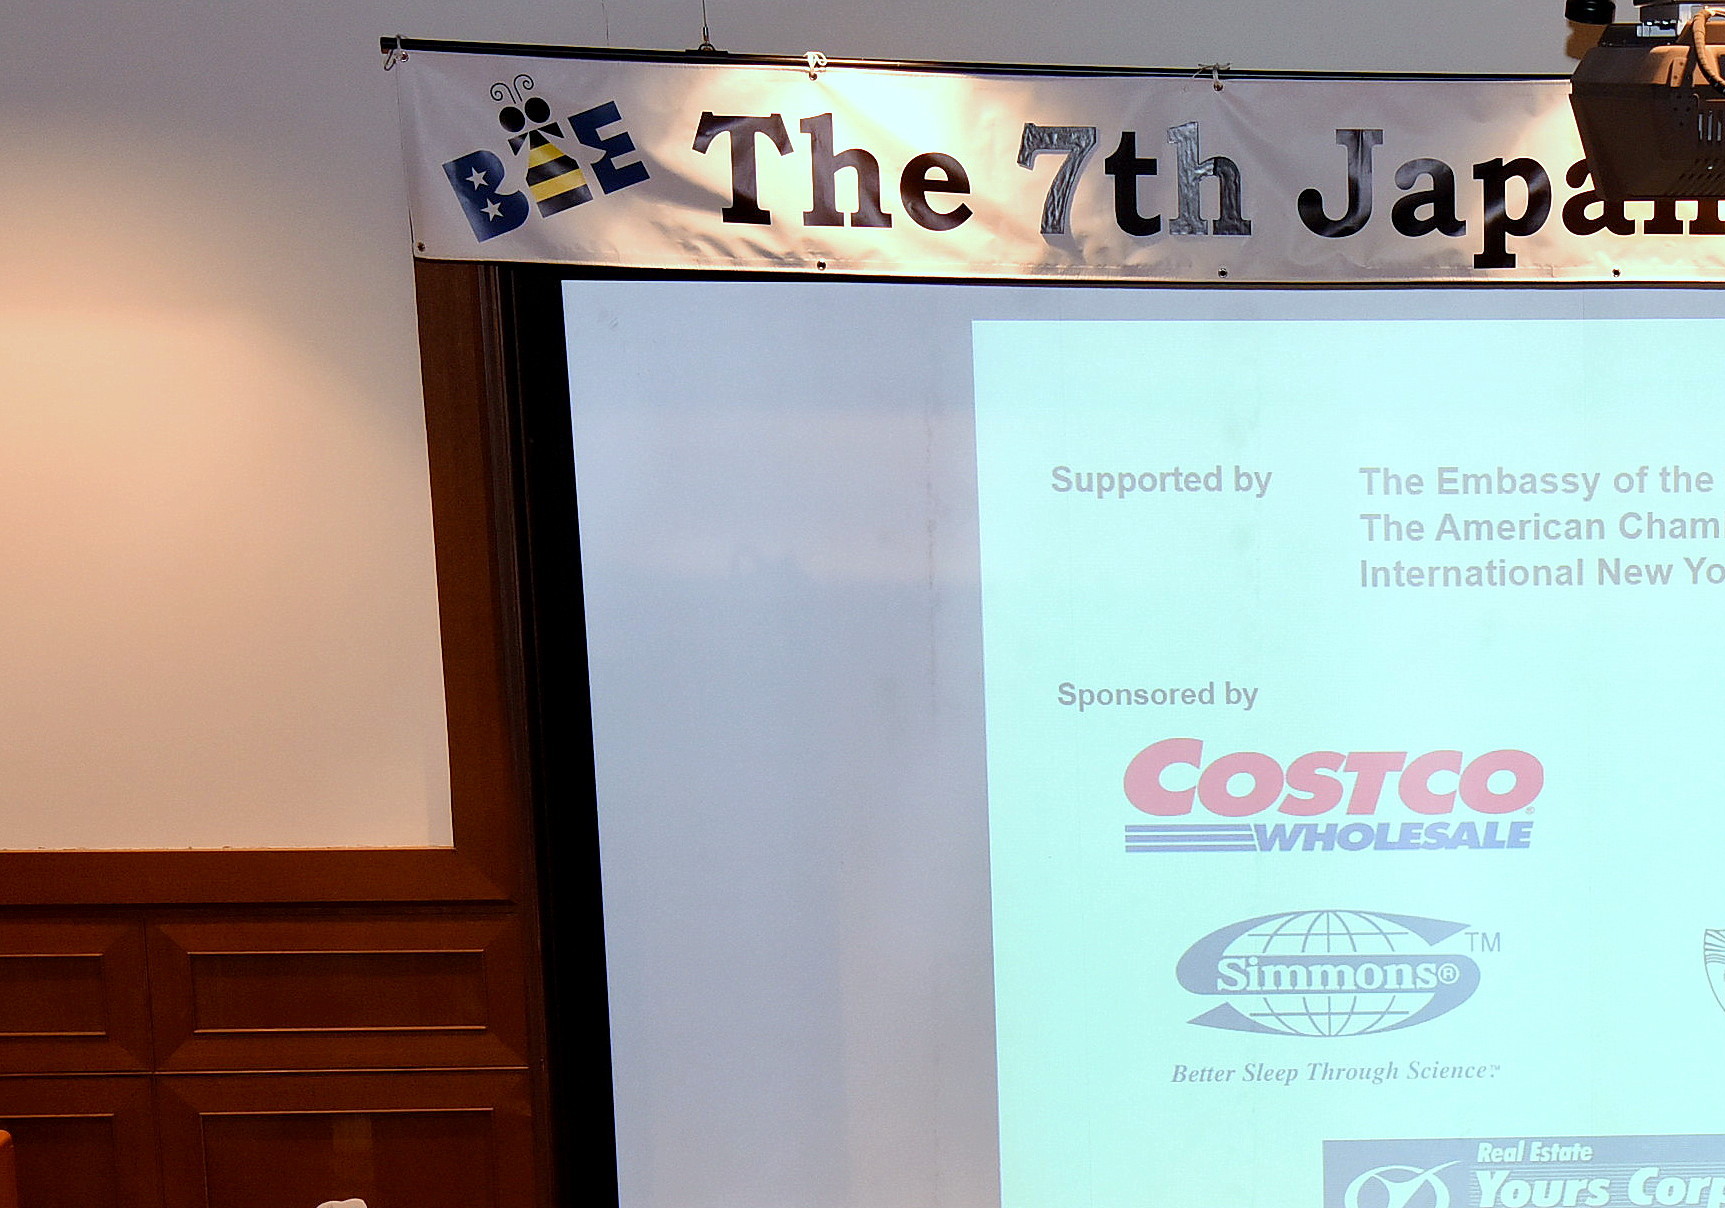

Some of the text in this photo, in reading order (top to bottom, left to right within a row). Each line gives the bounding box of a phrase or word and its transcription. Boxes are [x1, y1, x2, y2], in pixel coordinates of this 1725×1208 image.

[693, 111, 974, 230] The
[1018, 121, 1252, 238] 7th
[1052, 465, 1272, 500] Supported by
[1360, 468, 1423, 494] The
[1437, 467, 1601, 501] Embassy
[1614, 466, 1648, 493] of
[1659, 466, 1713, 492] the
[1360, 514, 1423, 541] The
[1435, 513, 1605, 541] American
[1361, 558, 1584, 587] International
[1598, 558, 1674, 585] New
[1057, 681, 1259, 712] Sponsored by
[1124, 737, 1543, 816] COSTCO
[1255, 818, 1534, 853] WHOLESALE
[1171, 1064, 1236, 1083] Better
[1242, 1062, 1299, 1087] Sleep
[1307, 1061, 1399, 1084] Through
[1477, 1140, 1594, 1164] Real Estate
